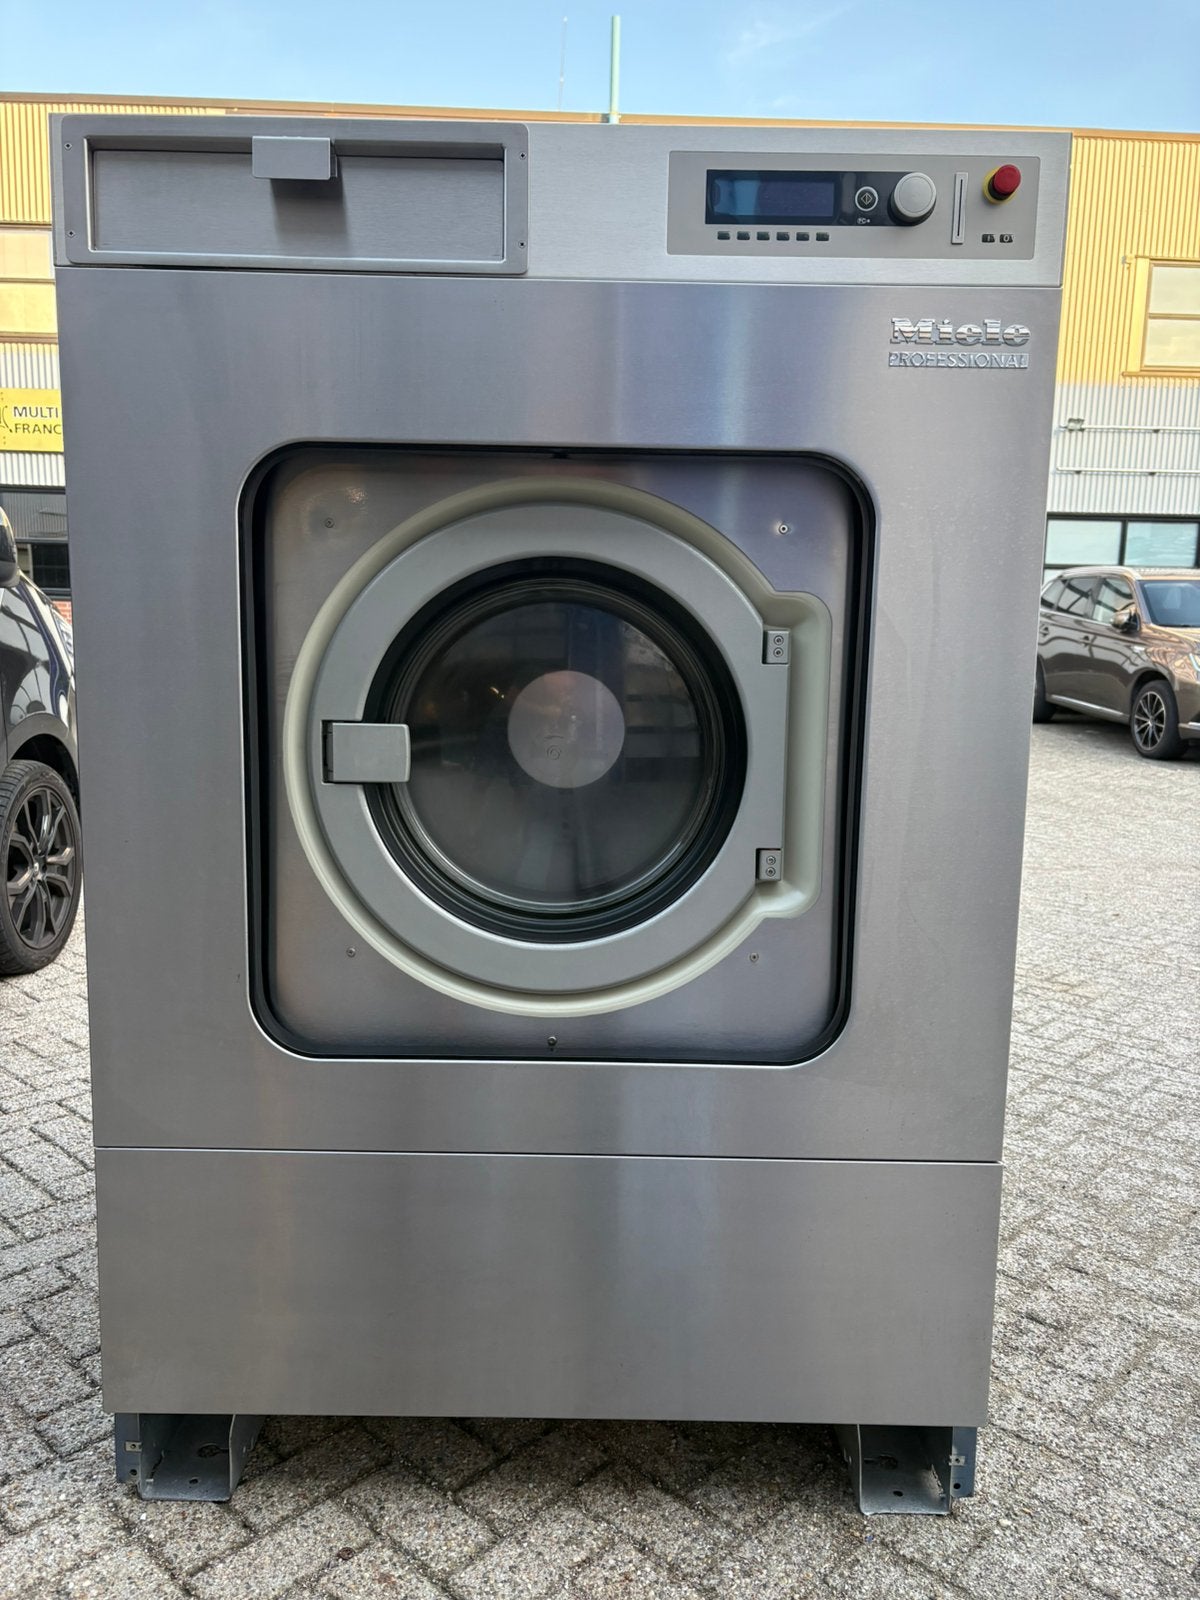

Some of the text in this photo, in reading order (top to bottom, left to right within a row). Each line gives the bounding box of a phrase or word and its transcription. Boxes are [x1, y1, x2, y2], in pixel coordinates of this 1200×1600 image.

[889, 317, 1031, 346] Miele
[888, 352, 1030, 369] PROFESSIONAL
[13, 406, 59, 418] MULTI
